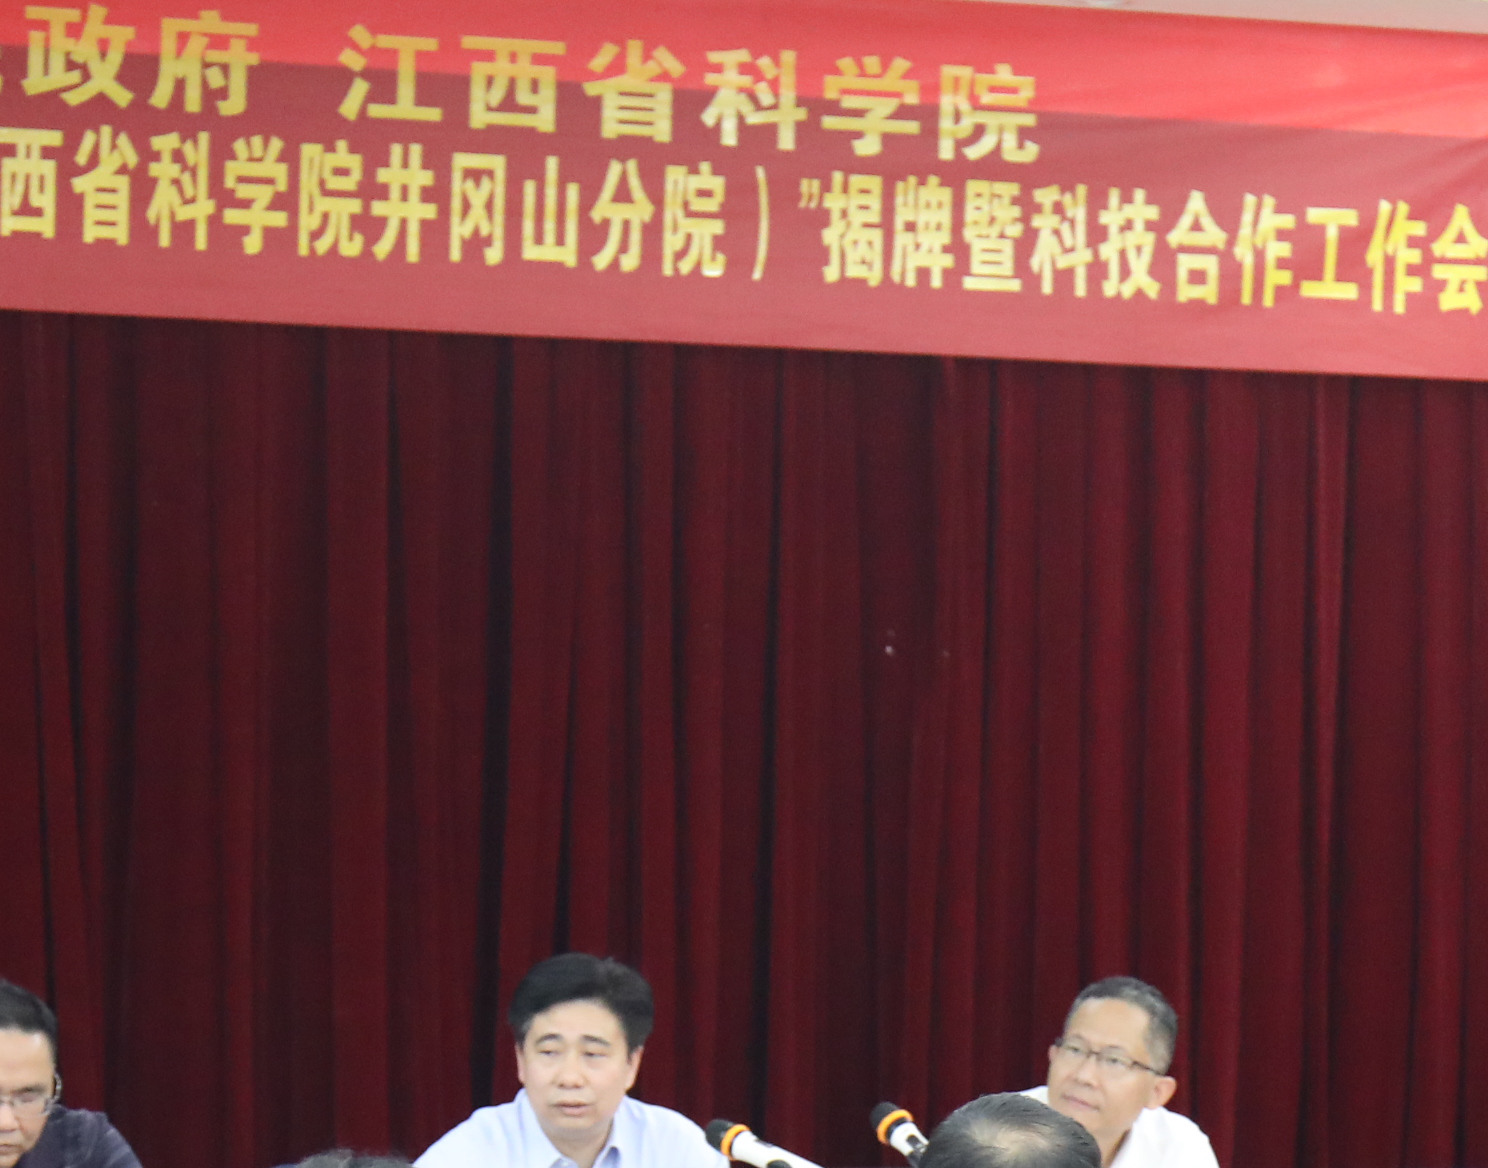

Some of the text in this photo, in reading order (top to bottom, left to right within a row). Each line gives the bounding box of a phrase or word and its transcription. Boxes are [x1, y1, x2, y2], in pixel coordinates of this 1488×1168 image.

[337, 24, 1041, 162] 江西省科学院
